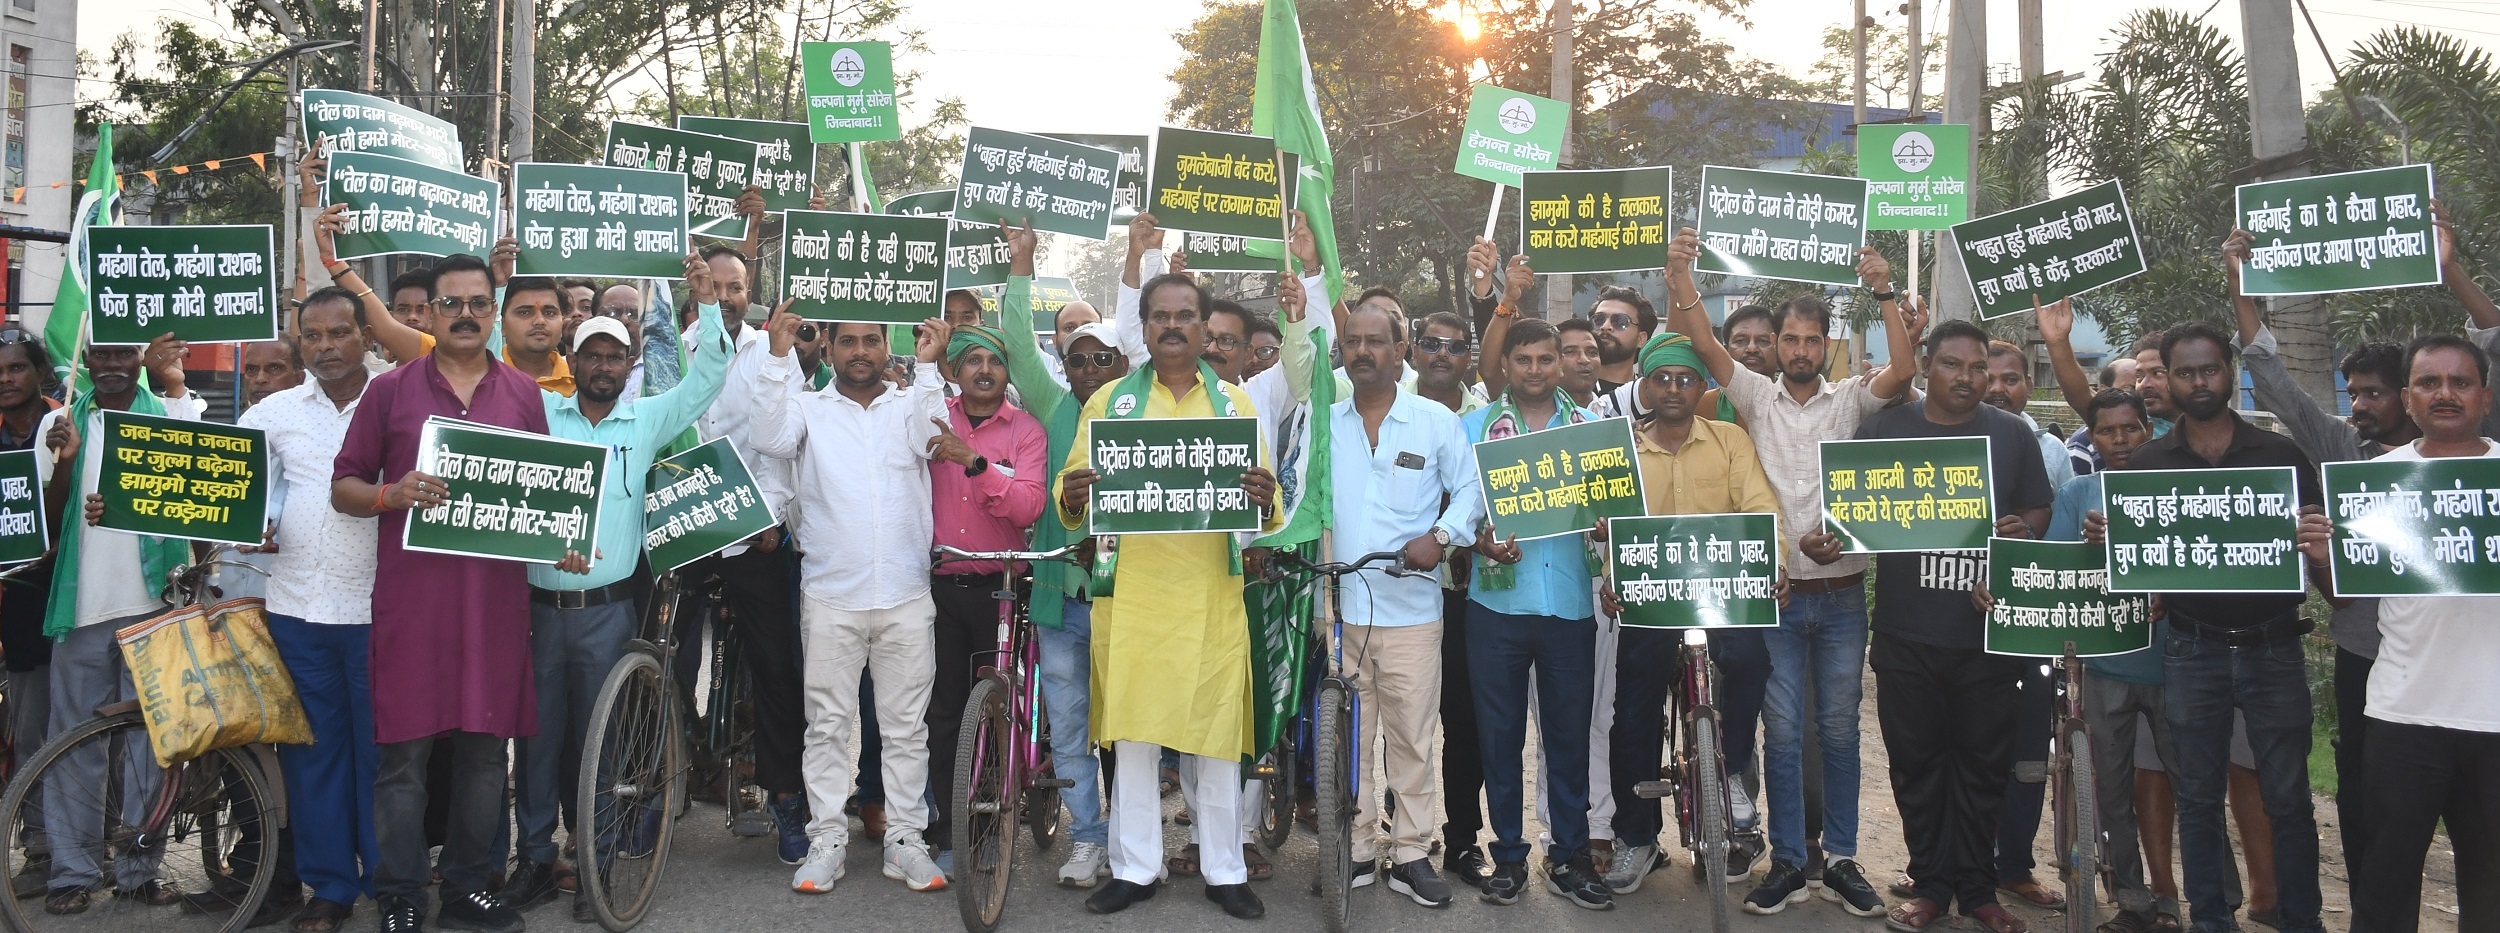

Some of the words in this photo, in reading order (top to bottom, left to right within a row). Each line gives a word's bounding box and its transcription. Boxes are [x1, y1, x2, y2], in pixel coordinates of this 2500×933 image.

[810, 95, 844, 108] कल्पना
[846, 89, 867, 114] मुर्मू
[866, 90, 892, 107] सोरेन
[1468, 130, 1511, 154] हेमन्त
[1514, 142, 1552, 163] सोरेन
[1007, 147, 1028, 174] हुई
[1027, 150, 1069, 180] महंगाई
[1069, 158, 1086, 181] की
[1087, 166, 1110, 189] मार,
[1177, 152, 1233, 181] जुमलेबाजी
[1234, 154, 1252, 180] बंद
[1253, 159, 1276, 185] करो,
[370, 173, 390, 193] का
[392, 176, 418, 197] दाम
[419, 181, 461, 208] बढ़ाकर
[462, 190, 491, 219] भारी,
[526, 181, 564, 212] महंगा
[567, 184, 595, 216] तेल,
[599, 184, 636, 214] महंगा
[964, 182, 983, 208] चुप
[986, 181, 1011, 205] क्यों
[1012, 183, 1023, 208] है
[1026, 186, 1048, 212] केंद्र
[1160, 184, 1202, 213] महंगाई
[1204, 193, 1219, 212] पर
[1220, 195, 1254, 215] लगाम
[1908, 176, 1932, 202] मुर्मू
[1932, 176, 1964, 194] सोरेन
[1530, 195, 1570, 226] झामुमो
[1578, 193, 1595, 218] की
[1602, 193, 1612, 218] है
[1619, 196, 1662, 217] ललकार,
[1709, 185, 1741, 218] पेट्रोल
[1742, 189, 1756, 215] के
[1758, 196, 1782, 218] दाम
[1784, 192, 1795, 219] ने
[1797, 194, 1823, 229] तोड़ी
[1824, 202, 1857, 228] कमर,
[2247, 199, 2291, 233] महंगाई
[2299, 204, 2318, 227] का
[2325, 196, 2337, 224] ये
[2345, 192, 2376, 222] कैसा
[792, 228, 830, 259] बोकारो
[838, 230, 854, 260] की
[861, 231, 870, 262] है
[878, 232, 898, 264] यही
[906, 241, 938, 272] पुकार,
[1530, 230, 1553, 248] कम
[1555, 224, 1578, 248] करो
[1581, 221, 1620, 249] महंगाई
[1622, 220, 1638, 245] की
[1640, 221, 1662, 244] मार!
[98, 244, 137, 278] महंगा
[140, 247, 170, 280] तेल,
[174, 244, 215, 278] महंगा
[2251, 238, 2302, 272] साइकिल
[2303, 242, 2321, 265] पर
[2323, 239, 2352, 264] आया
[2354, 237, 2376, 269] पूरा
[790, 268, 830, 304] महंगाई
[830, 278, 852, 300] कम
[854, 272, 873, 301] करे
[874, 271, 895, 305] केंद्र
[99, 287, 129, 317] फेल
[136, 294, 164, 326] हुआ
[172, 285, 205, 316] मोदी
[214, 287, 264, 315] शासन!
[120, 424, 194, 446] जब-जब
[198, 434, 252, 452] जनता
[118, 448, 144, 464] पर
[148, 451, 192, 472] जुल्म
[1098, 440, 1130, 475] पेट्रोल
[1132, 440, 1146, 468] के
[1149, 446, 1173, 468] दाम
[1175, 439, 1186, 467] ने
[1189, 437, 1215, 475] तोड़ी
[1217, 444, 1252, 468] कमर,
[1488, 459, 1530, 492] झामुमो
[1536, 453, 1555, 479] की
[1560, 450, 1573, 475] है
[1578, 447, 1629, 472] ललकार,
[120, 472, 186, 496] झामुमो
[191, 480, 250, 501] सड़कों
[1829, 470, 1855, 491] आम
[1865, 462, 1904, 490] आदमी
[1913, 462, 1935, 488] करे
[1943, 466, 1983, 495] पुकार,
[133, 498, 158, 516] पर
[1099, 490, 1134, 513] जनता
[1136, 481, 1163, 512] माँगे
[1165, 489, 1194, 512] राहत
[1197, 481, 1214, 511] की
[1830, 494, 1849, 525] बंद
[1852, 496, 1877, 522] करो
[1879, 495, 1890, 521] ये
[1893, 501, 1914, 529] लूट
[1916, 493, 1934, 520] की
[2156, 487, 2177, 526] हुई
[2180, 486, 2230, 521] महंगाई
[2233, 486, 2254, 516] की
[2257, 494, 2289, 519] मार,
[1620, 535, 1658, 568] महंगाई
[1666, 542, 1681, 564] का
[1689, 535, 1698, 564] ये
[1706, 534, 1732, 562] कैसा
[2114, 544, 2136, 575] चुप
[2142, 535, 2169, 566] क्यों
[2173, 536, 2186, 567] है
[2190, 534, 2218, 569] केंद्र
[2012, 562, 2055, 592] साइकिल
[2057, 570, 2076, 589] अब
[1994, 598, 2011, 627] केंद्र
[2013, 606, 2049, 627] सरकार
[2050, 602, 2066, 628] की
[2068, 603, 2078, 627] ये
[2080, 601, 2105, 627] कैसी
[2132, 597, 2144, 623] है?
